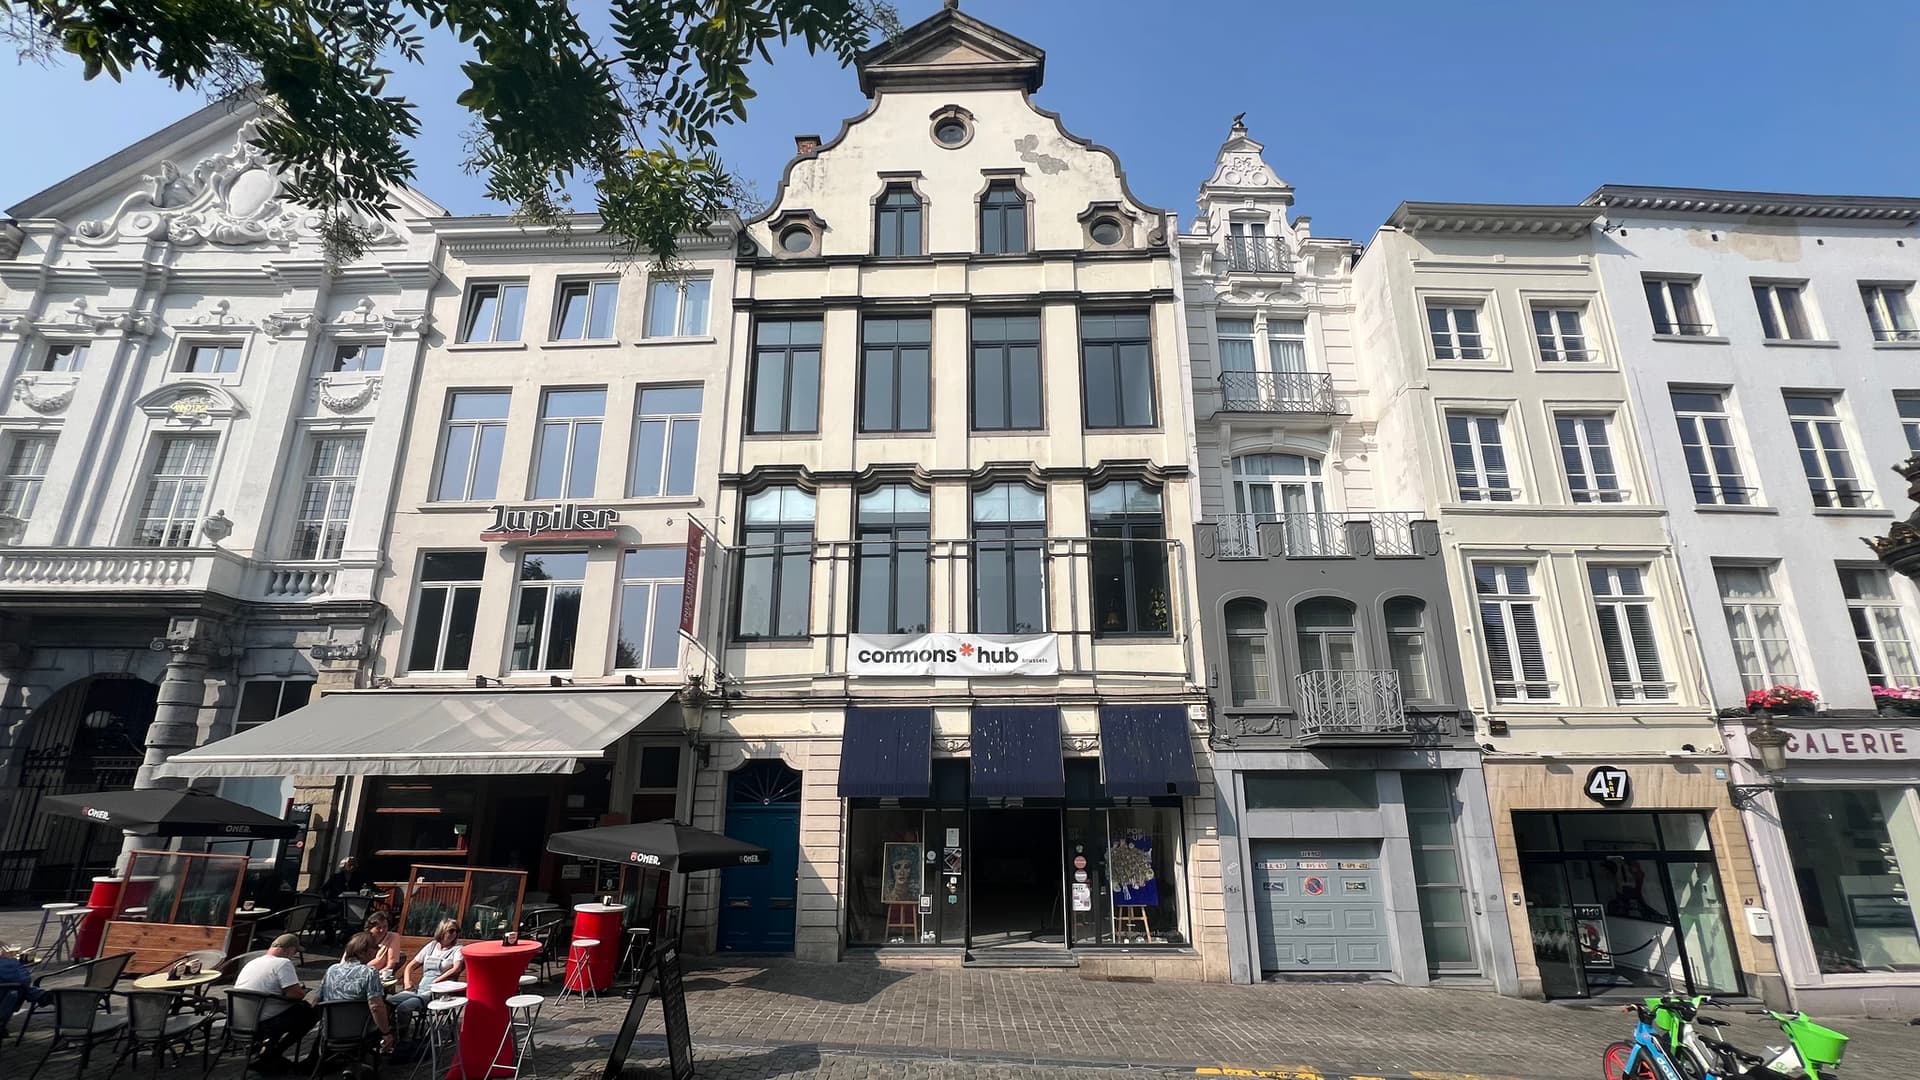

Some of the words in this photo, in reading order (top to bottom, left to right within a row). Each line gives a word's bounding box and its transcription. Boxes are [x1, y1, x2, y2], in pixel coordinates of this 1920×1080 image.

[482, 503, 618, 536] Jupiler
[858, 649, 957, 664] commons
[977, 647, 1018, 664] hub
[1786, 733, 1907, 754] GALERIE
[1589, 771, 1627, 798] 47
[636, 853, 661, 866] OMER.
